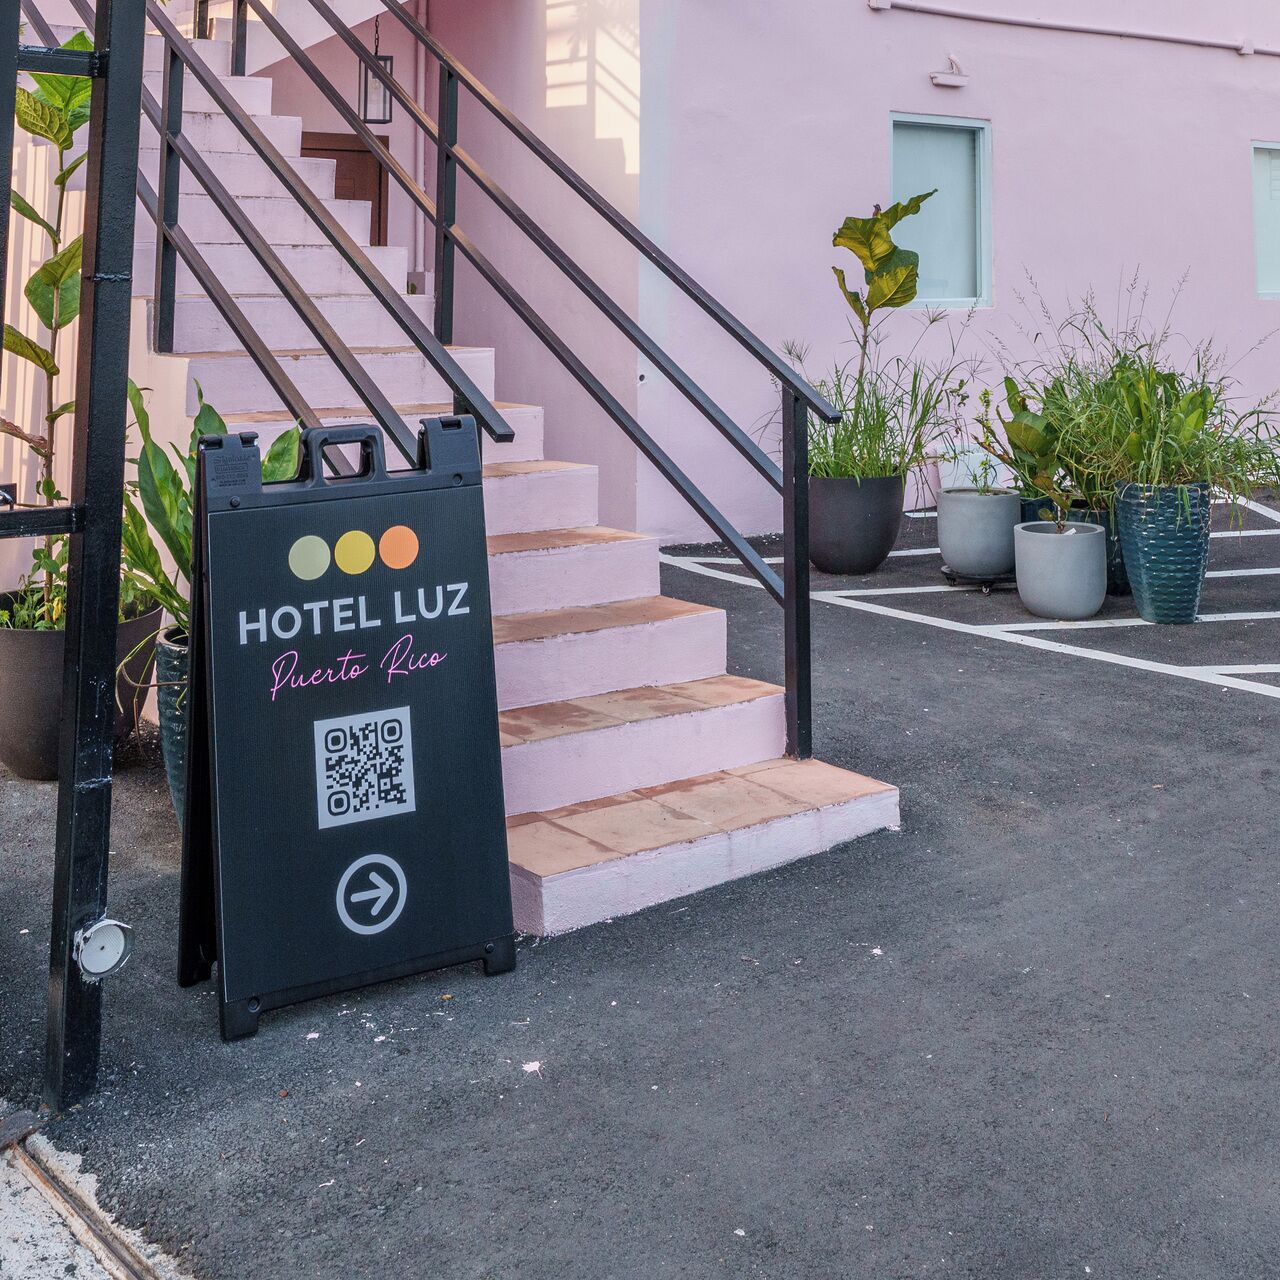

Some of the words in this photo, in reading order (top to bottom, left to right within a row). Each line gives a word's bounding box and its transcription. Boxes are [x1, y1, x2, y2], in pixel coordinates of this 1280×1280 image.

[239, 595, 382, 645] HOTEL
[394, 582, 470, 624] LUZ
[270, 650, 369, 701] Puerto
[380, 634, 448, 683] Rico
